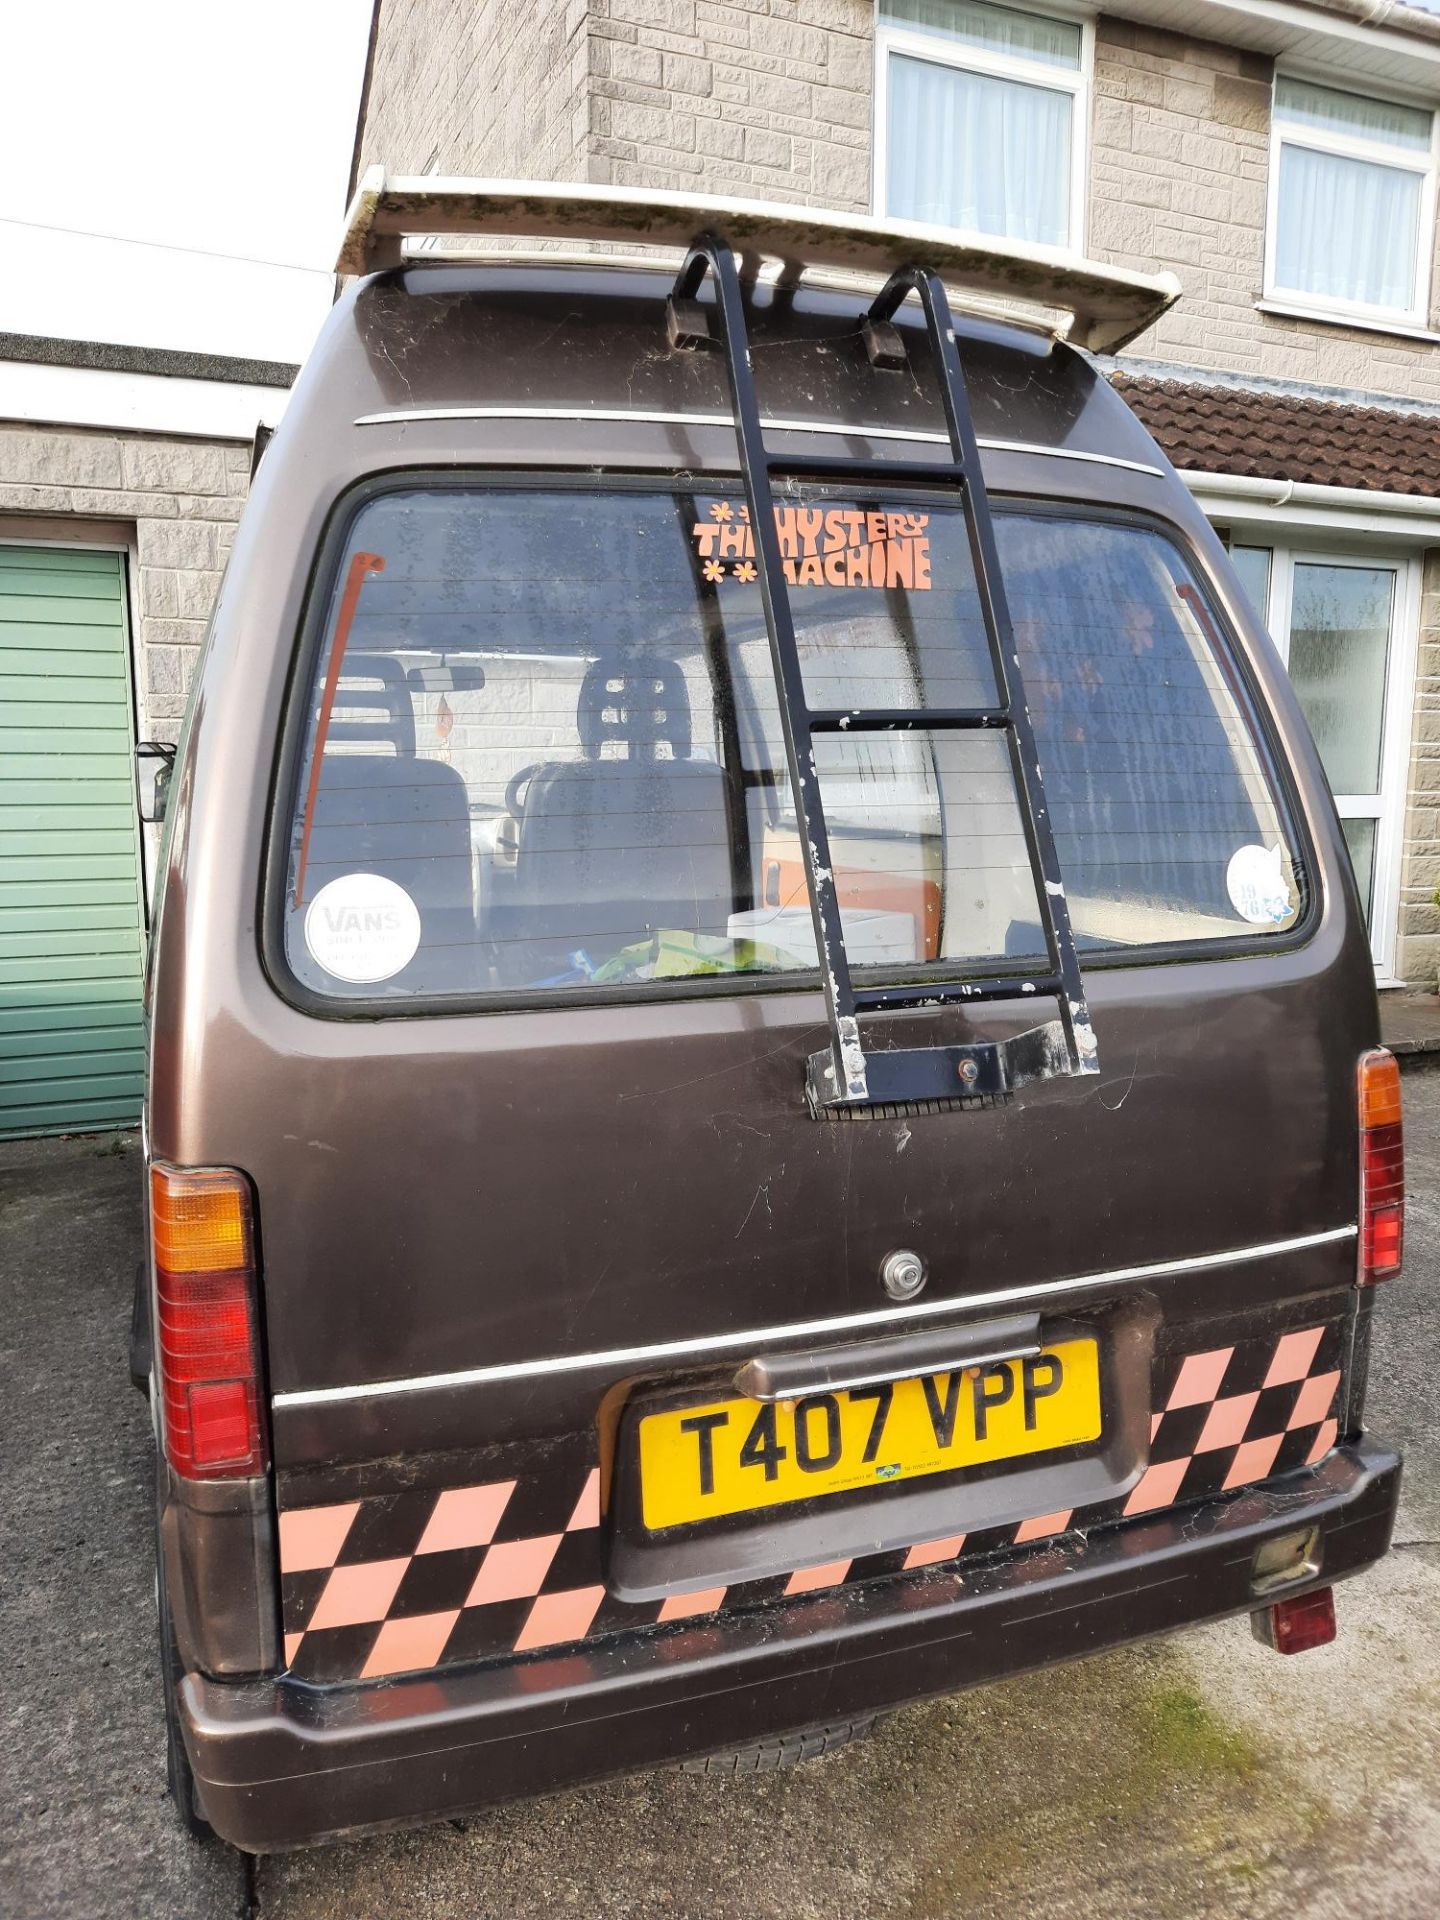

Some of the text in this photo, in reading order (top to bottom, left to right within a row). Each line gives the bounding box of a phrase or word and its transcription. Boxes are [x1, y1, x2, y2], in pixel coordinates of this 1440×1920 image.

[321, 905, 401, 933] VANS
[680, 1353, 1064, 1496] T407 VPP
